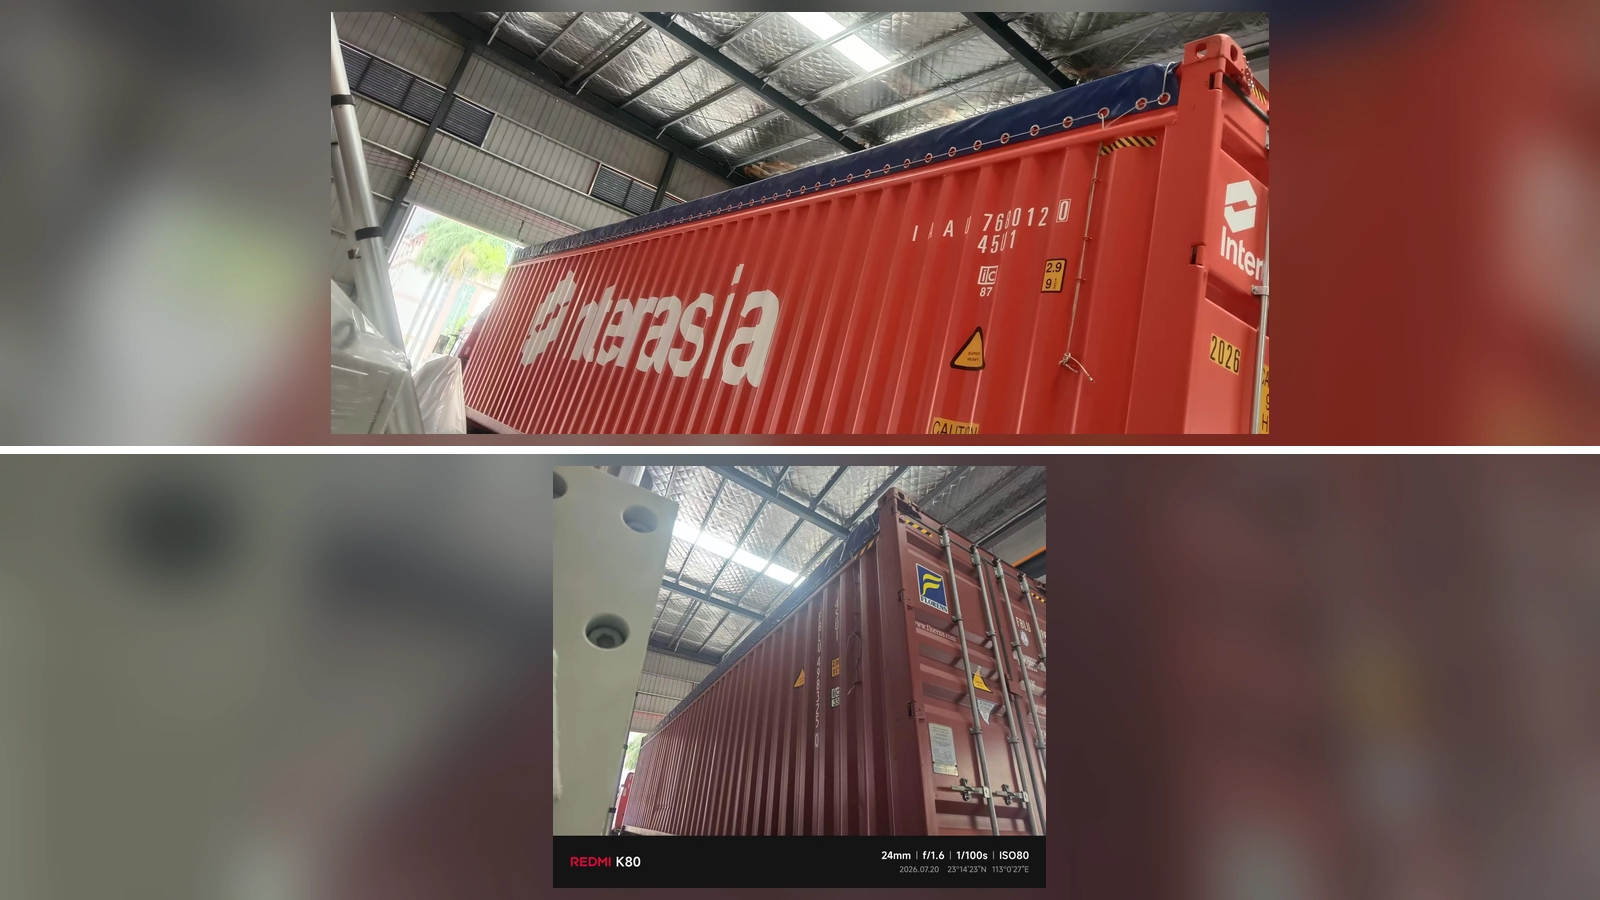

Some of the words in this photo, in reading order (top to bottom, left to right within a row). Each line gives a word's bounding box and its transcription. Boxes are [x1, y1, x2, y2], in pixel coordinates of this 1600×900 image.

[912, 216, 972, 242] IAAU
[983, 207, 1049, 232] 768012
[1057, 199, 1070, 222] 0
[1046, 262, 1062, 273] 2.9
[980, 287, 993, 297] 87
[1210, 335, 1240, 373] 2026
